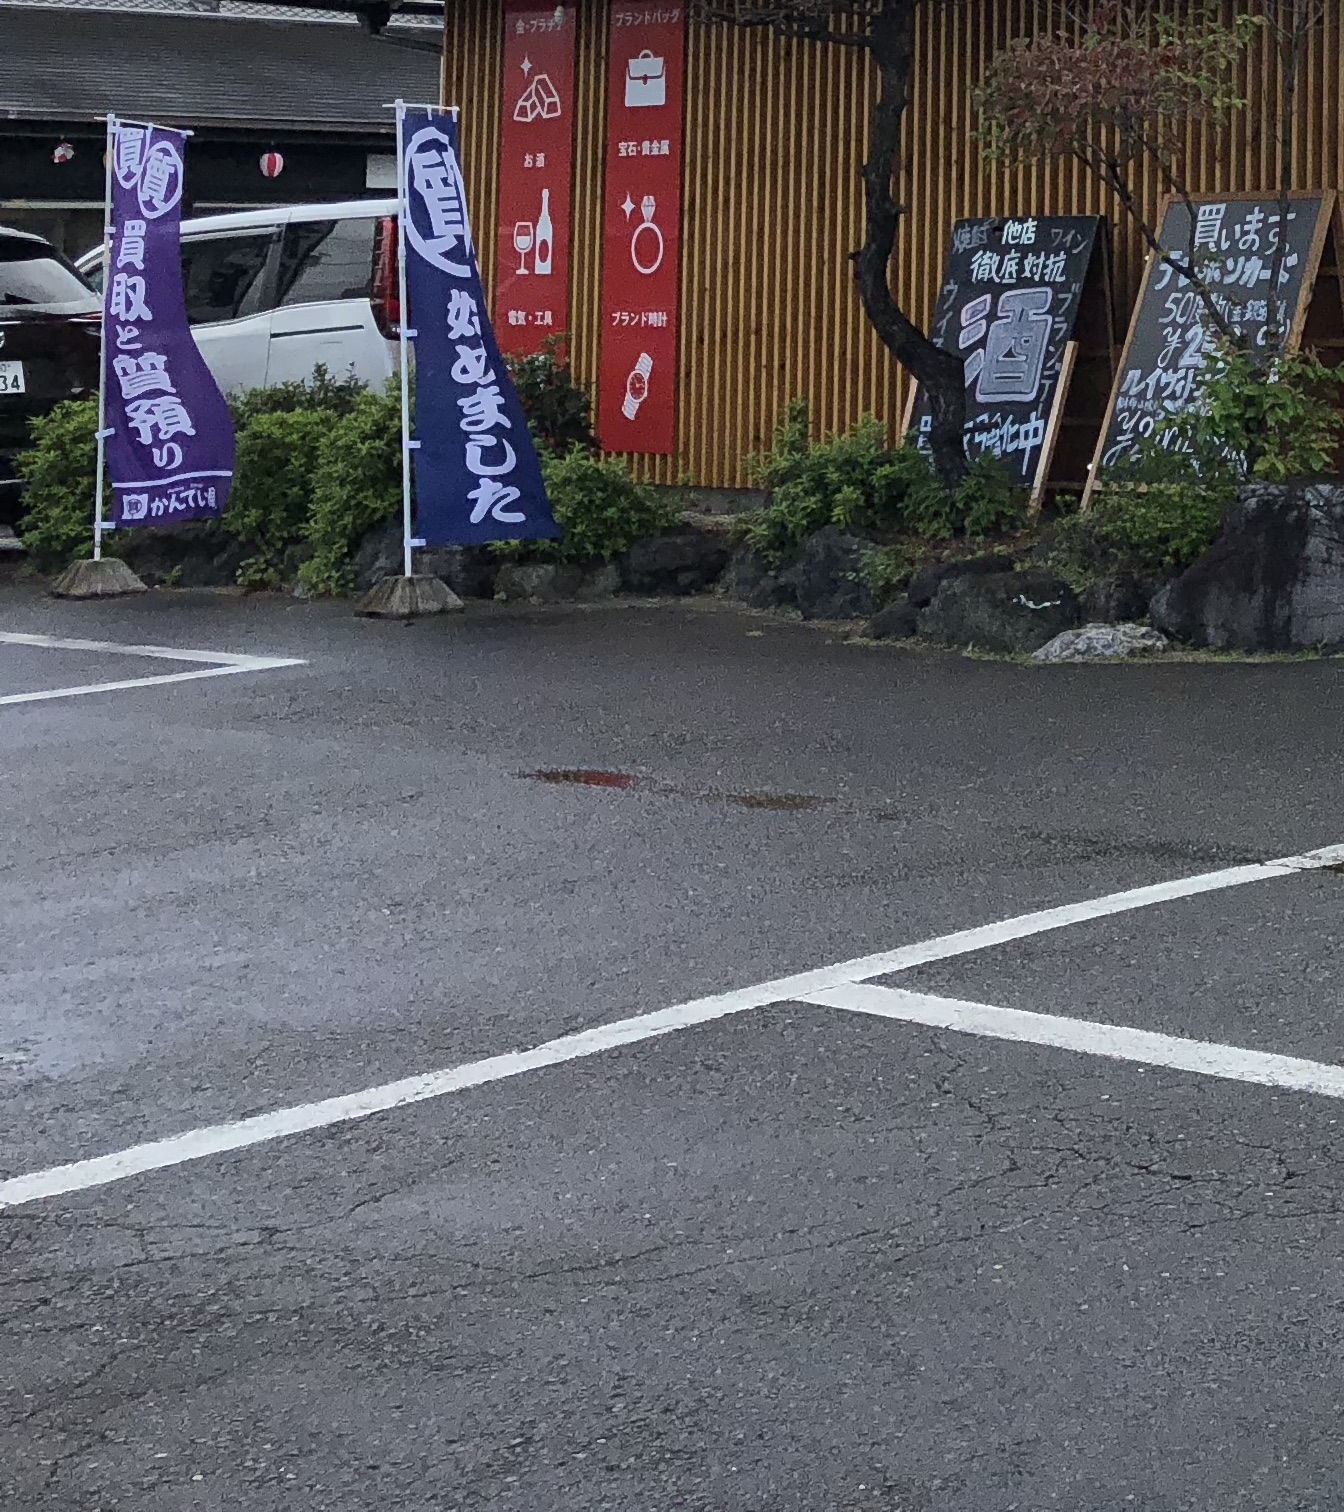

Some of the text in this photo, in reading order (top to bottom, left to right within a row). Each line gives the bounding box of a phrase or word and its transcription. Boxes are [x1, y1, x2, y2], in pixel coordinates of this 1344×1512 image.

[1002, 217, 1038, 245] 他店
[1051, 228, 1089, 254] ワイン
[969, 248, 1067, 284] 徹底対抗
